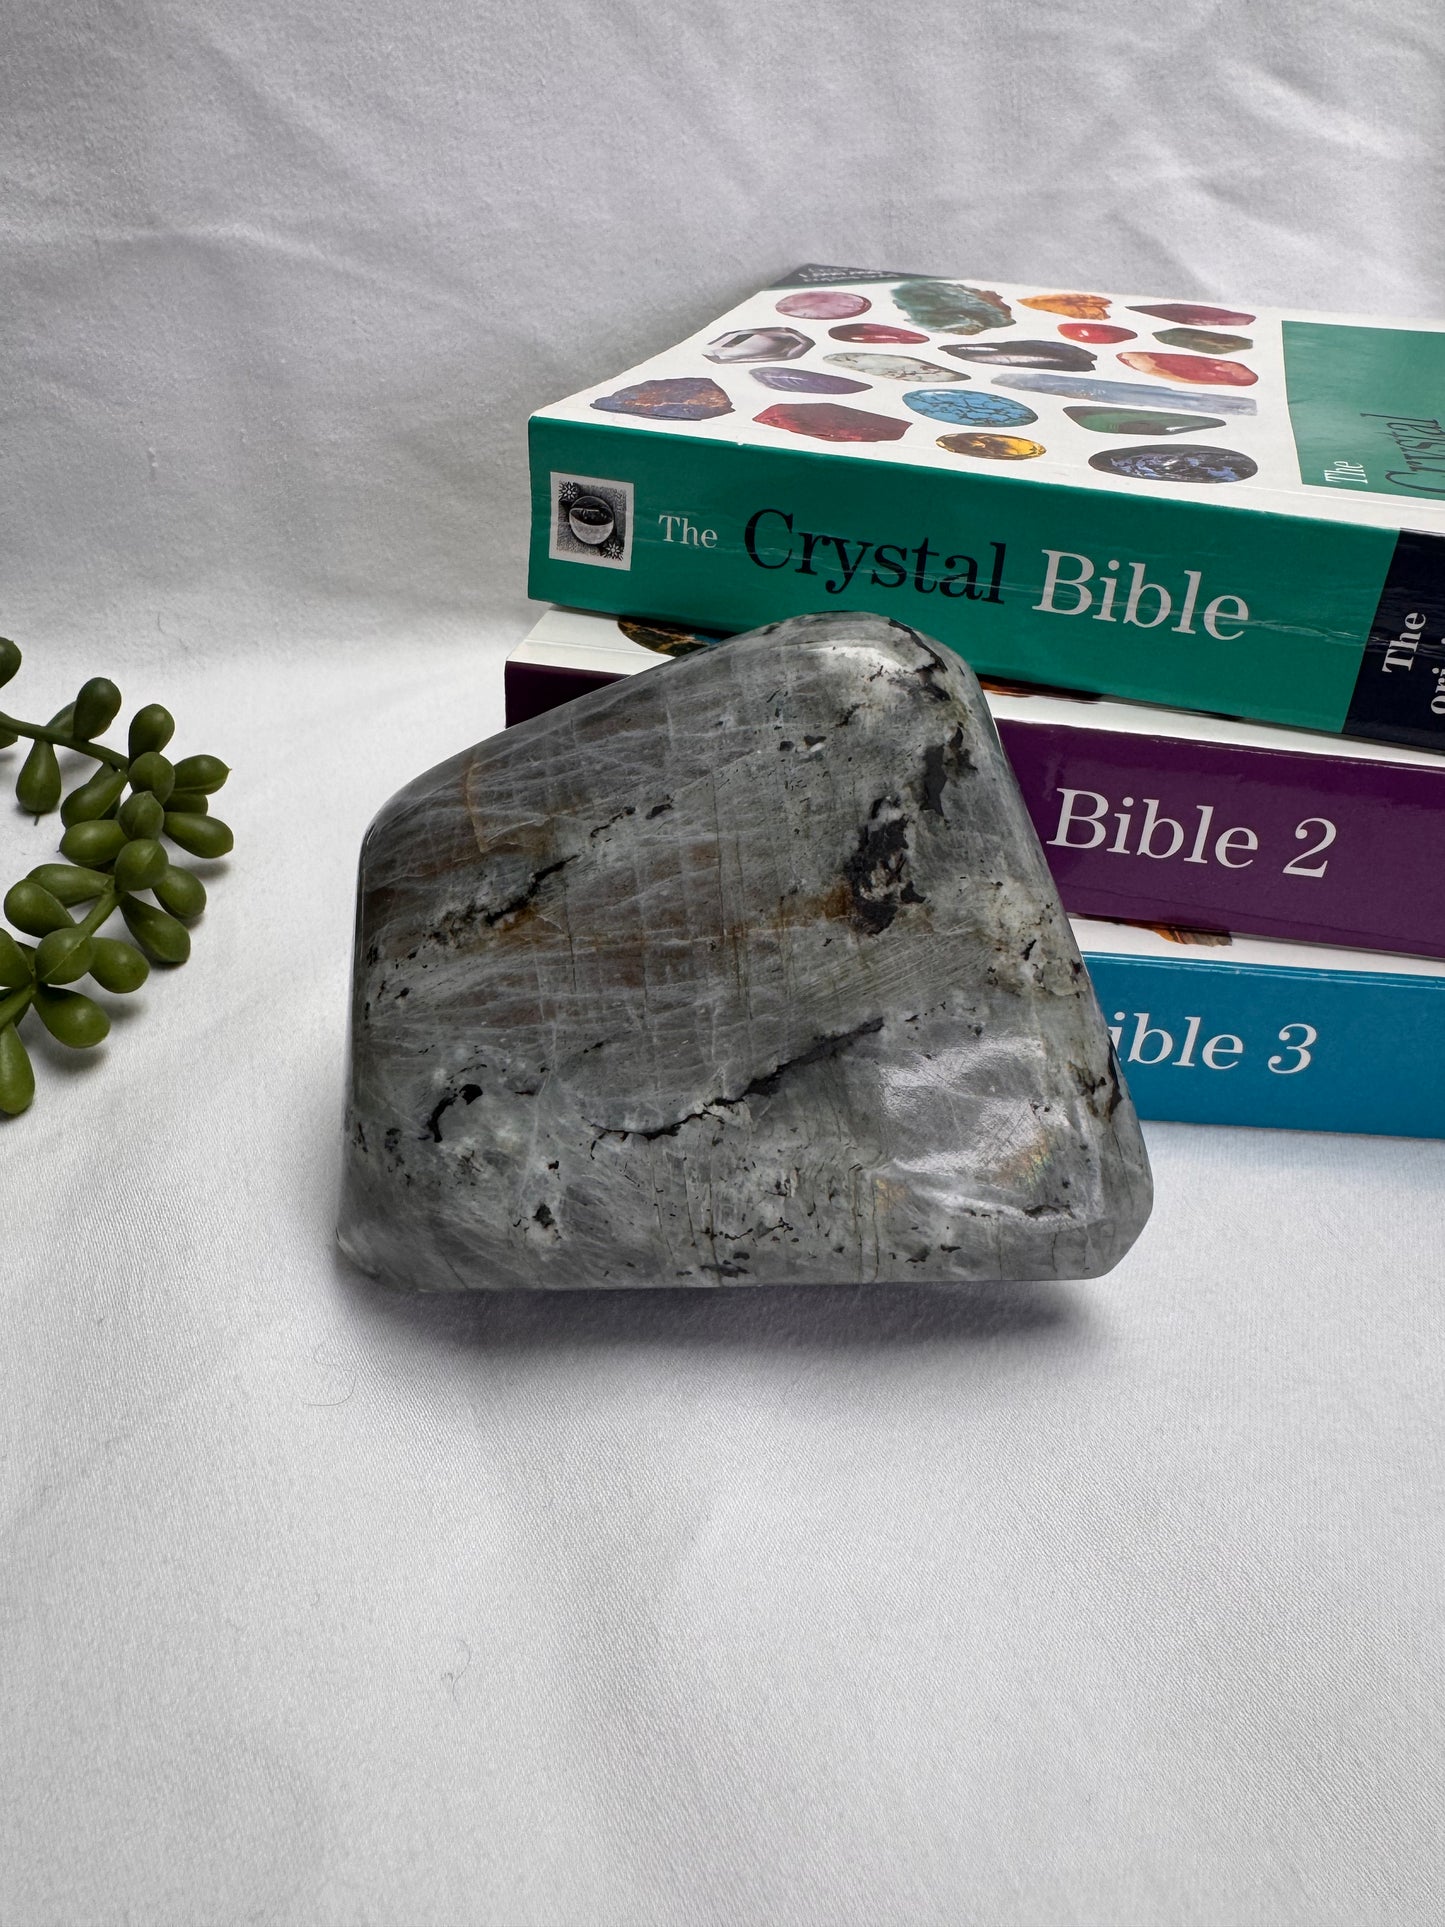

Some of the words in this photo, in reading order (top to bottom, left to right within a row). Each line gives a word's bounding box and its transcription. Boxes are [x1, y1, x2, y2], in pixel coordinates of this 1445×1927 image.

[1324, 461, 1369, 484] The
[658, 514, 718, 549] The
[744, 508, 1007, 606] Crystal
[1031, 548, 1250, 642] Bible
[1381, 612, 1426, 673] The
[1046, 787, 1259, 869] Bible
[1282, 817, 1337, 879] 2
[1107, 1011, 1244, 1071] ible
[1267, 1023, 1318, 1075] 3
